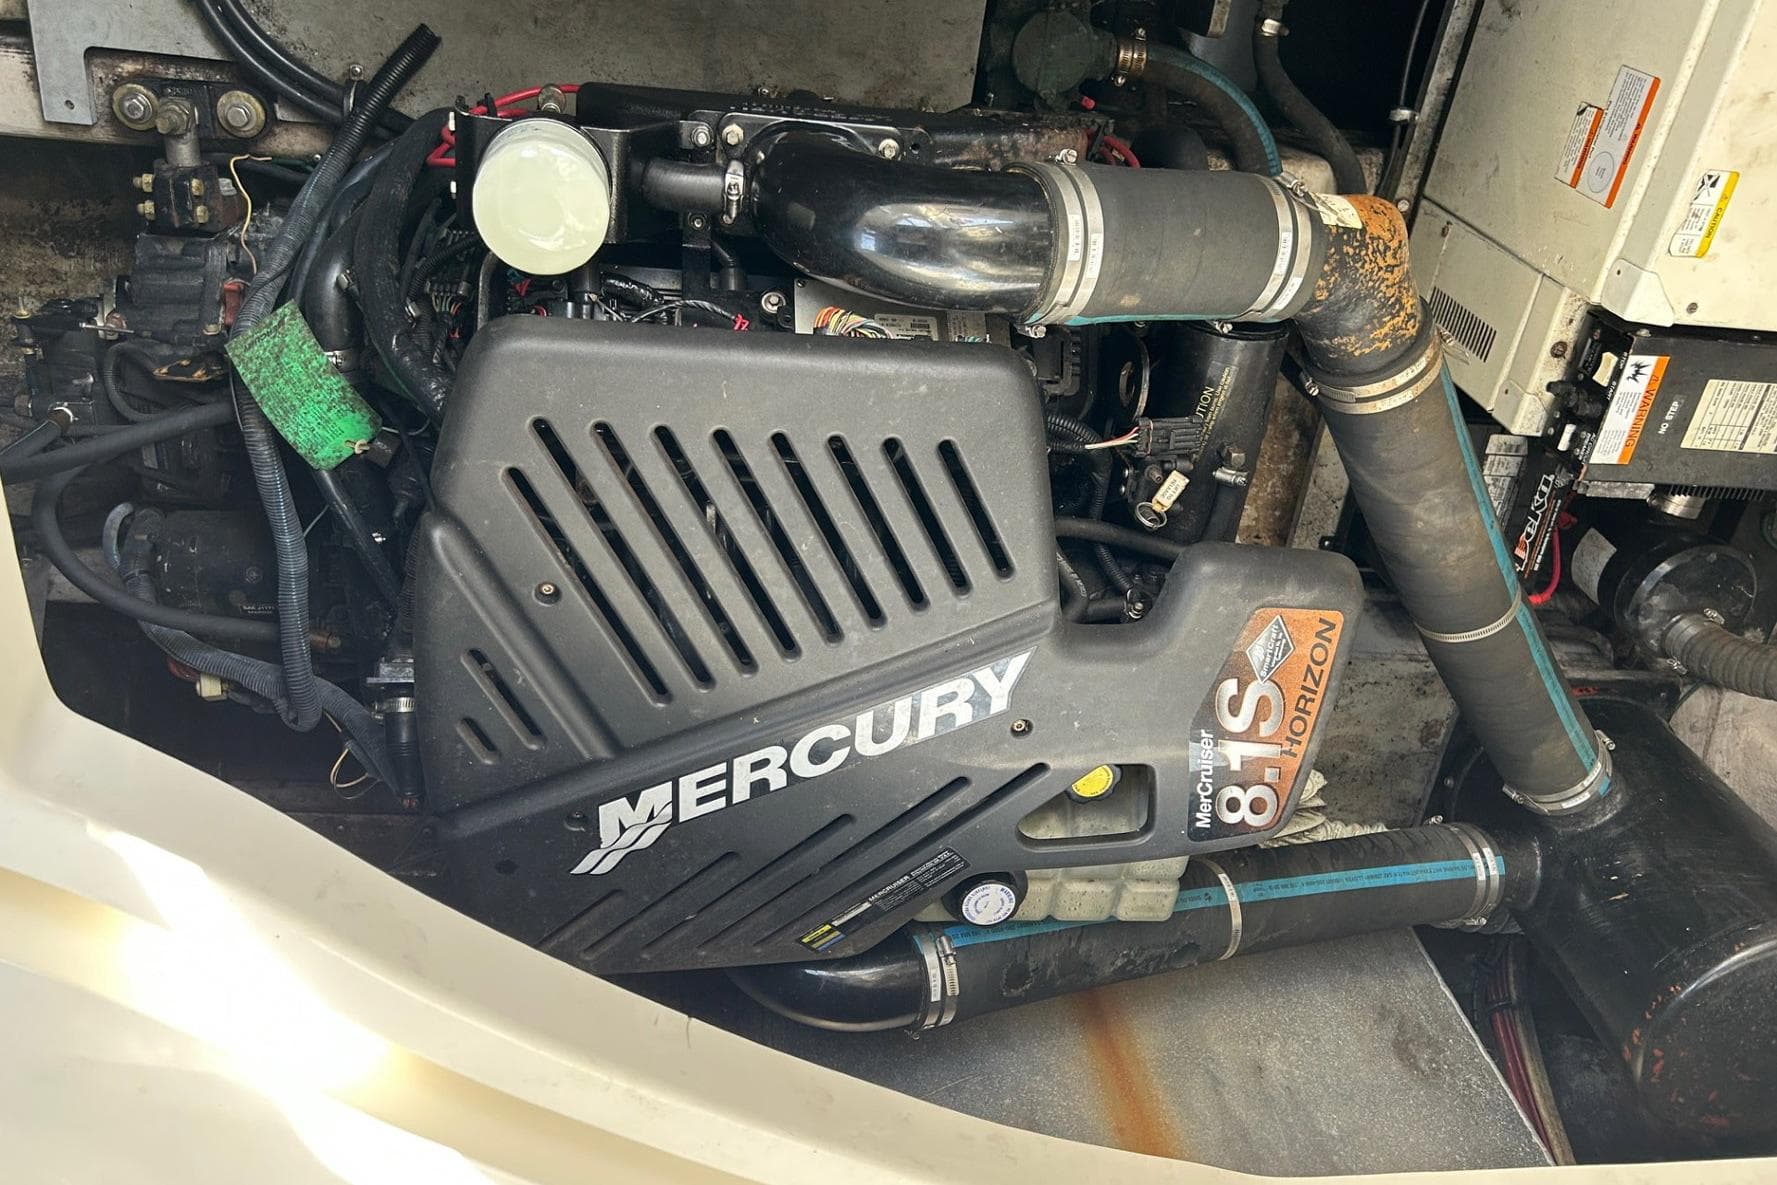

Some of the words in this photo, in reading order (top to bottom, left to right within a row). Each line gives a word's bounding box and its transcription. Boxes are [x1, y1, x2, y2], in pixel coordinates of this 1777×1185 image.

[1705, 207, 1722, 238] CAUTION
[1619, 351, 1628, 370] STOP
[1195, 386, 1215, 418] UTION
[1606, 381, 1617, 400] START
[1625, 388, 1658, 447] WARNING
[1658, 422, 1669, 435] NO
[1665, 401, 1680, 421] STEP
[1259, 623, 1280, 677] SmartCraft
[1281, 617, 1337, 758] HORIZON
[571, 650, 1034, 874] MERCURY
[1215, 678, 1285, 827] 8.1S
[1196, 729, 1214, 829] MerCruiser
[867, 875, 910, 902] MERCRUISER
